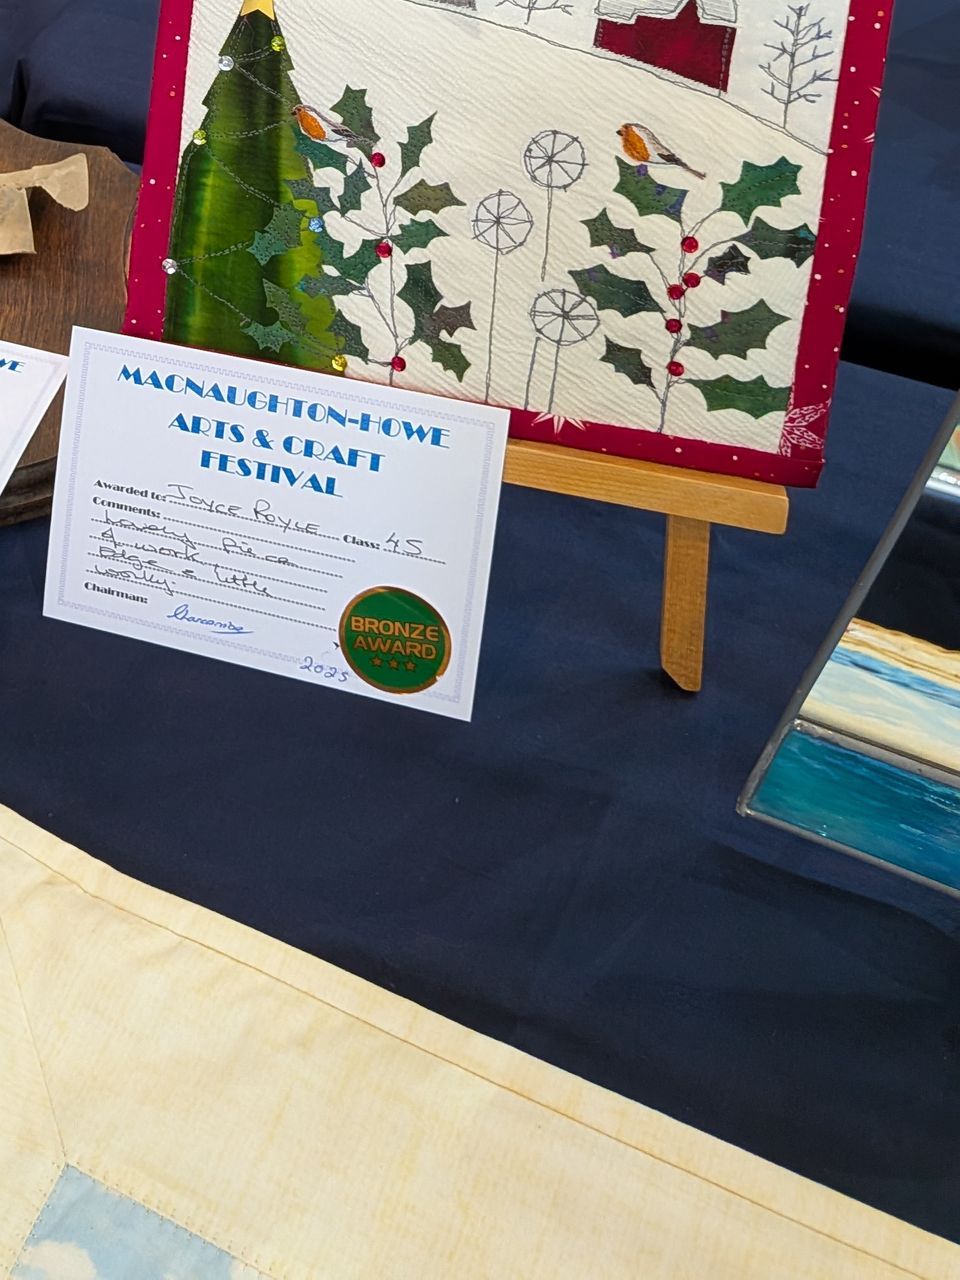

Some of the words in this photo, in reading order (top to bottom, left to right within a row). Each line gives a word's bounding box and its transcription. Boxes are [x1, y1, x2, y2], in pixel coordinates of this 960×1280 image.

[117, 365, 451, 449] MACNAUGHTON-HOWE
[168, 413, 245, 444] ARTS
[252, 429, 274, 450] &
[282, 436, 386, 472] CRAFT
[200, 449, 343, 498] FESTIVAL
[93, 496, 161, 519] Comments:
[94, 479, 148, 498] Awarded
[150, 490, 167, 502] to:
[343, 535, 380, 550] Class:
[84, 581, 148, 604] Chairman:
[351, 616, 439, 642] BRONZE
[354, 637, 437, 659] AWARD
